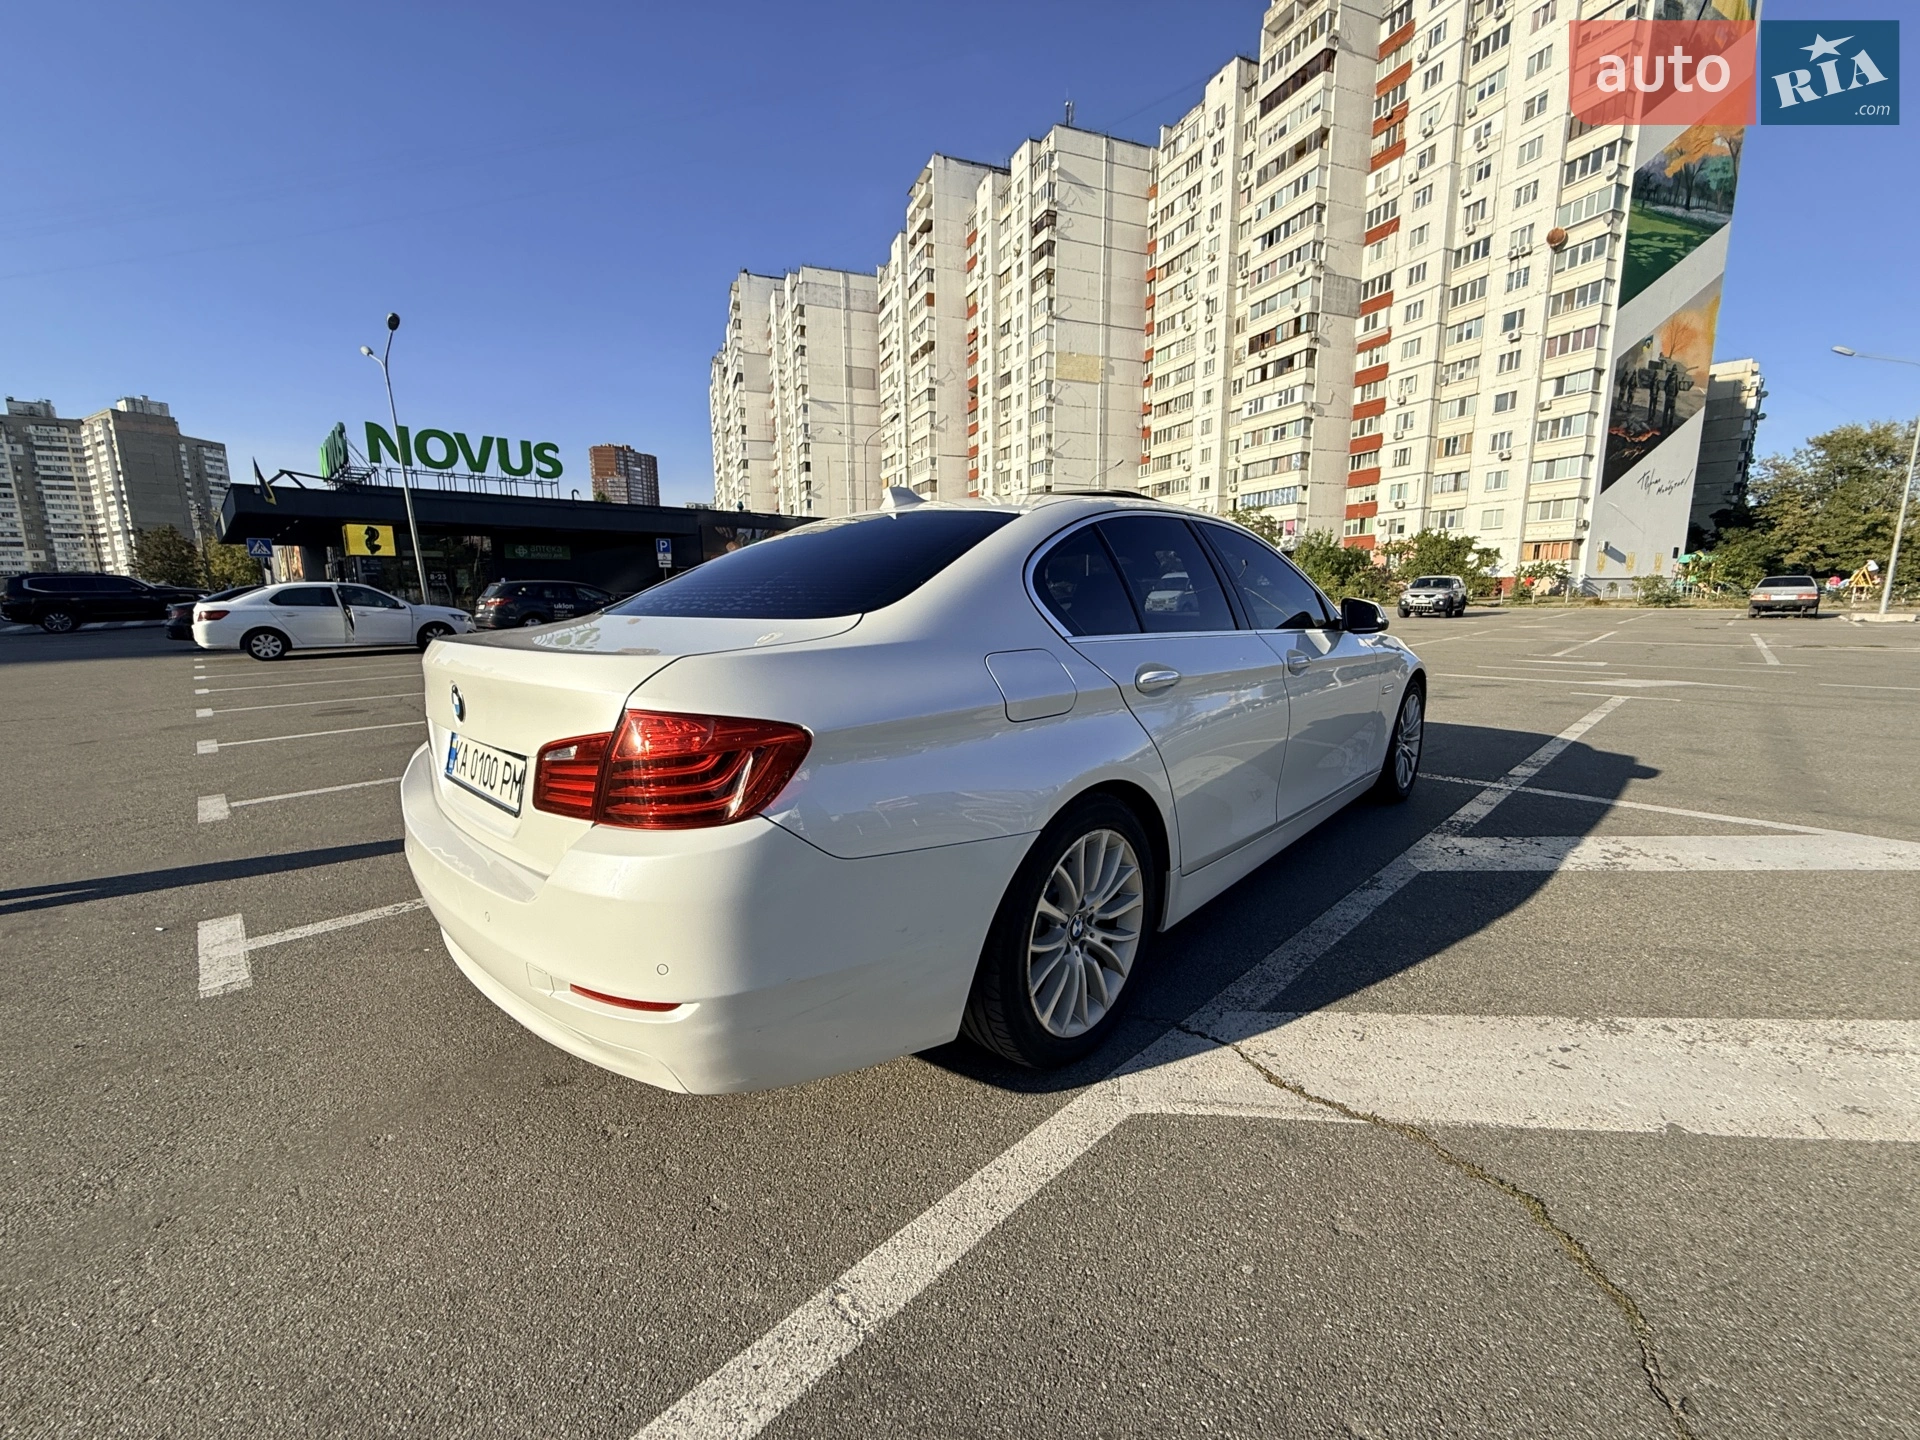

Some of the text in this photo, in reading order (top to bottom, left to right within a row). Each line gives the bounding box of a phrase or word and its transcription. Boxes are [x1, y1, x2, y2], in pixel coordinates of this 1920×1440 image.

[365, 421, 563, 479] NOVUS
[530, 544, 563, 553] аптека
[659, 540, 668, 552] P
[553, 602, 575, 610] uklon
[470, 748, 498, 790] 0100
